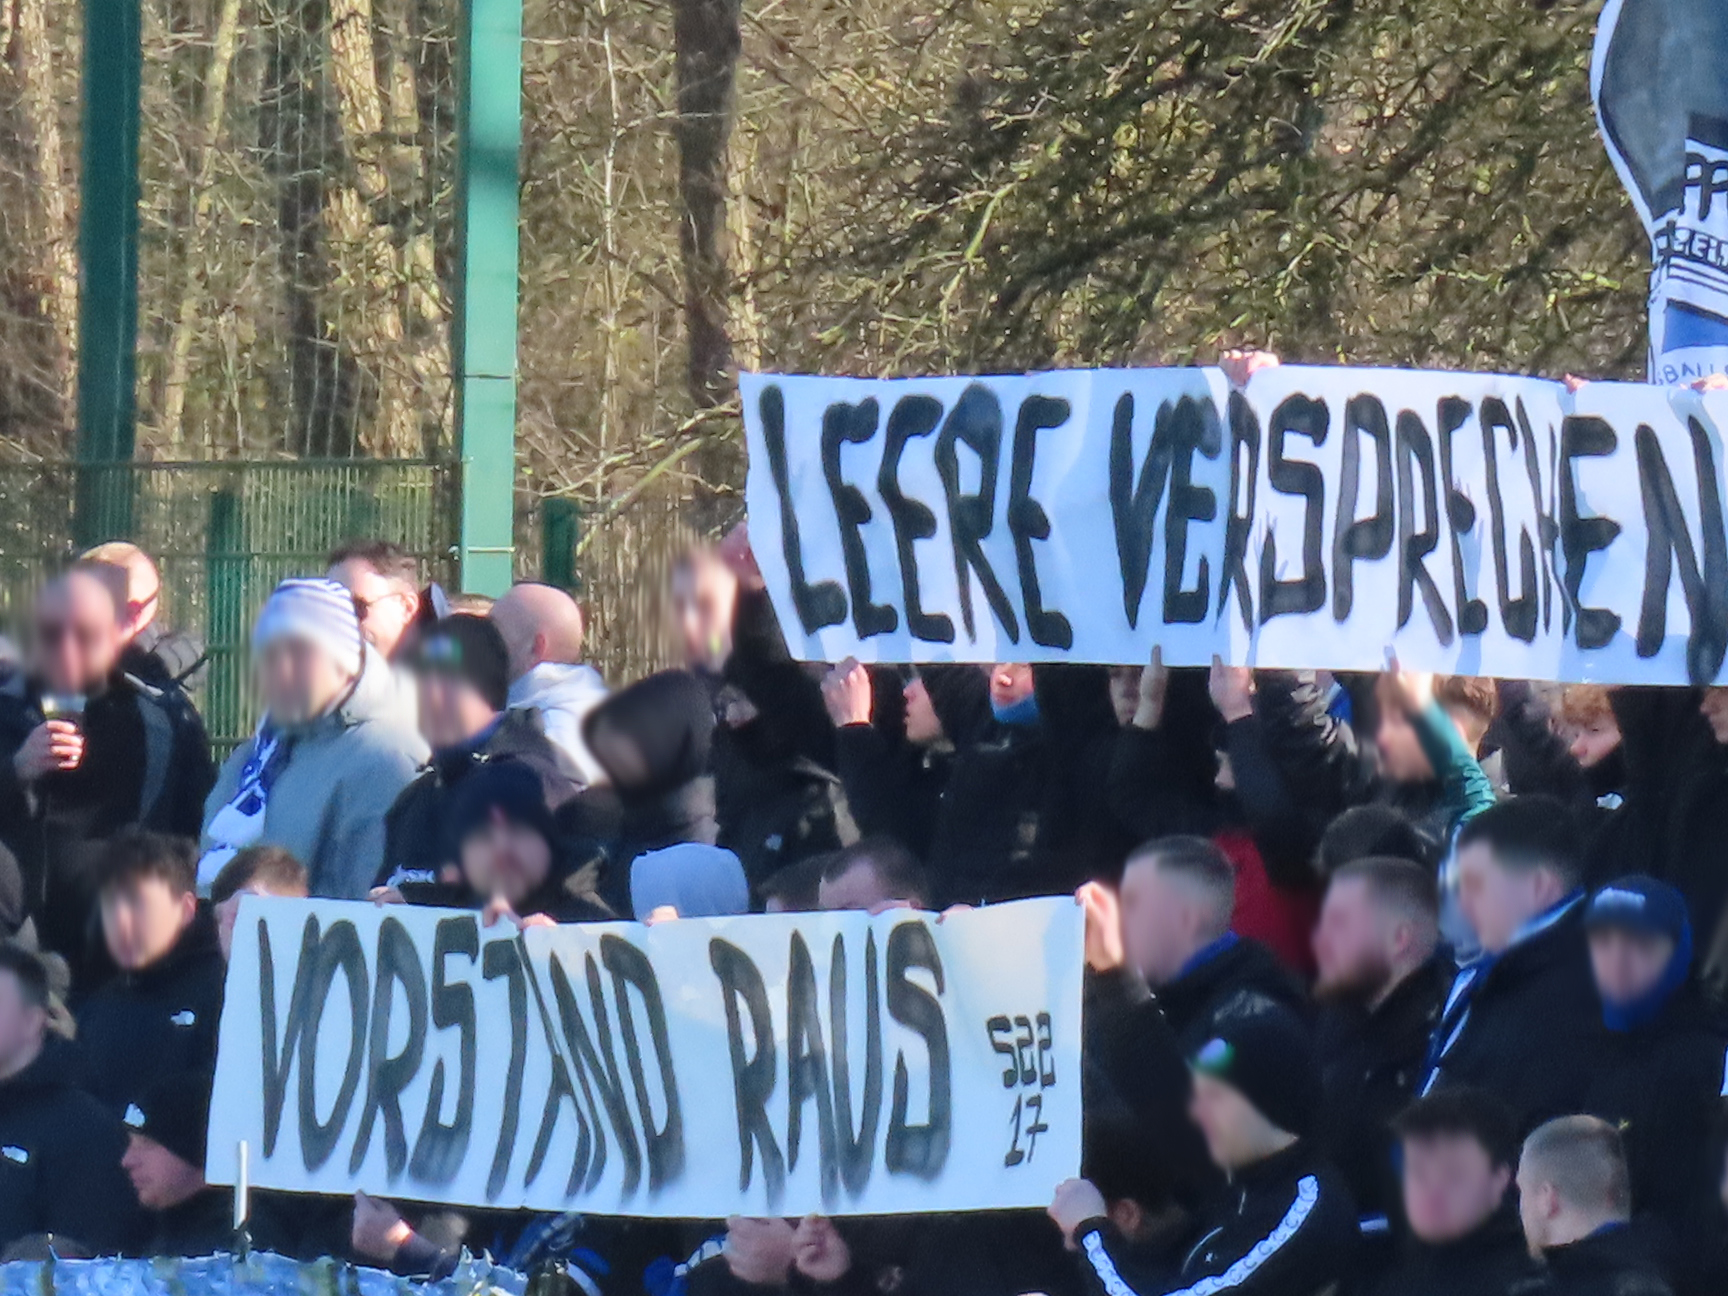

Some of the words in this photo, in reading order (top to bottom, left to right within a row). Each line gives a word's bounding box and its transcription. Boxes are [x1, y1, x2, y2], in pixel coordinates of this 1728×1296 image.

[760, 384, 1072, 651] LEERE
[258, 912, 684, 1204] VORSTAND
[708, 918, 953, 1208] RAUS
[1004, 1093, 1049, 1168] 17
